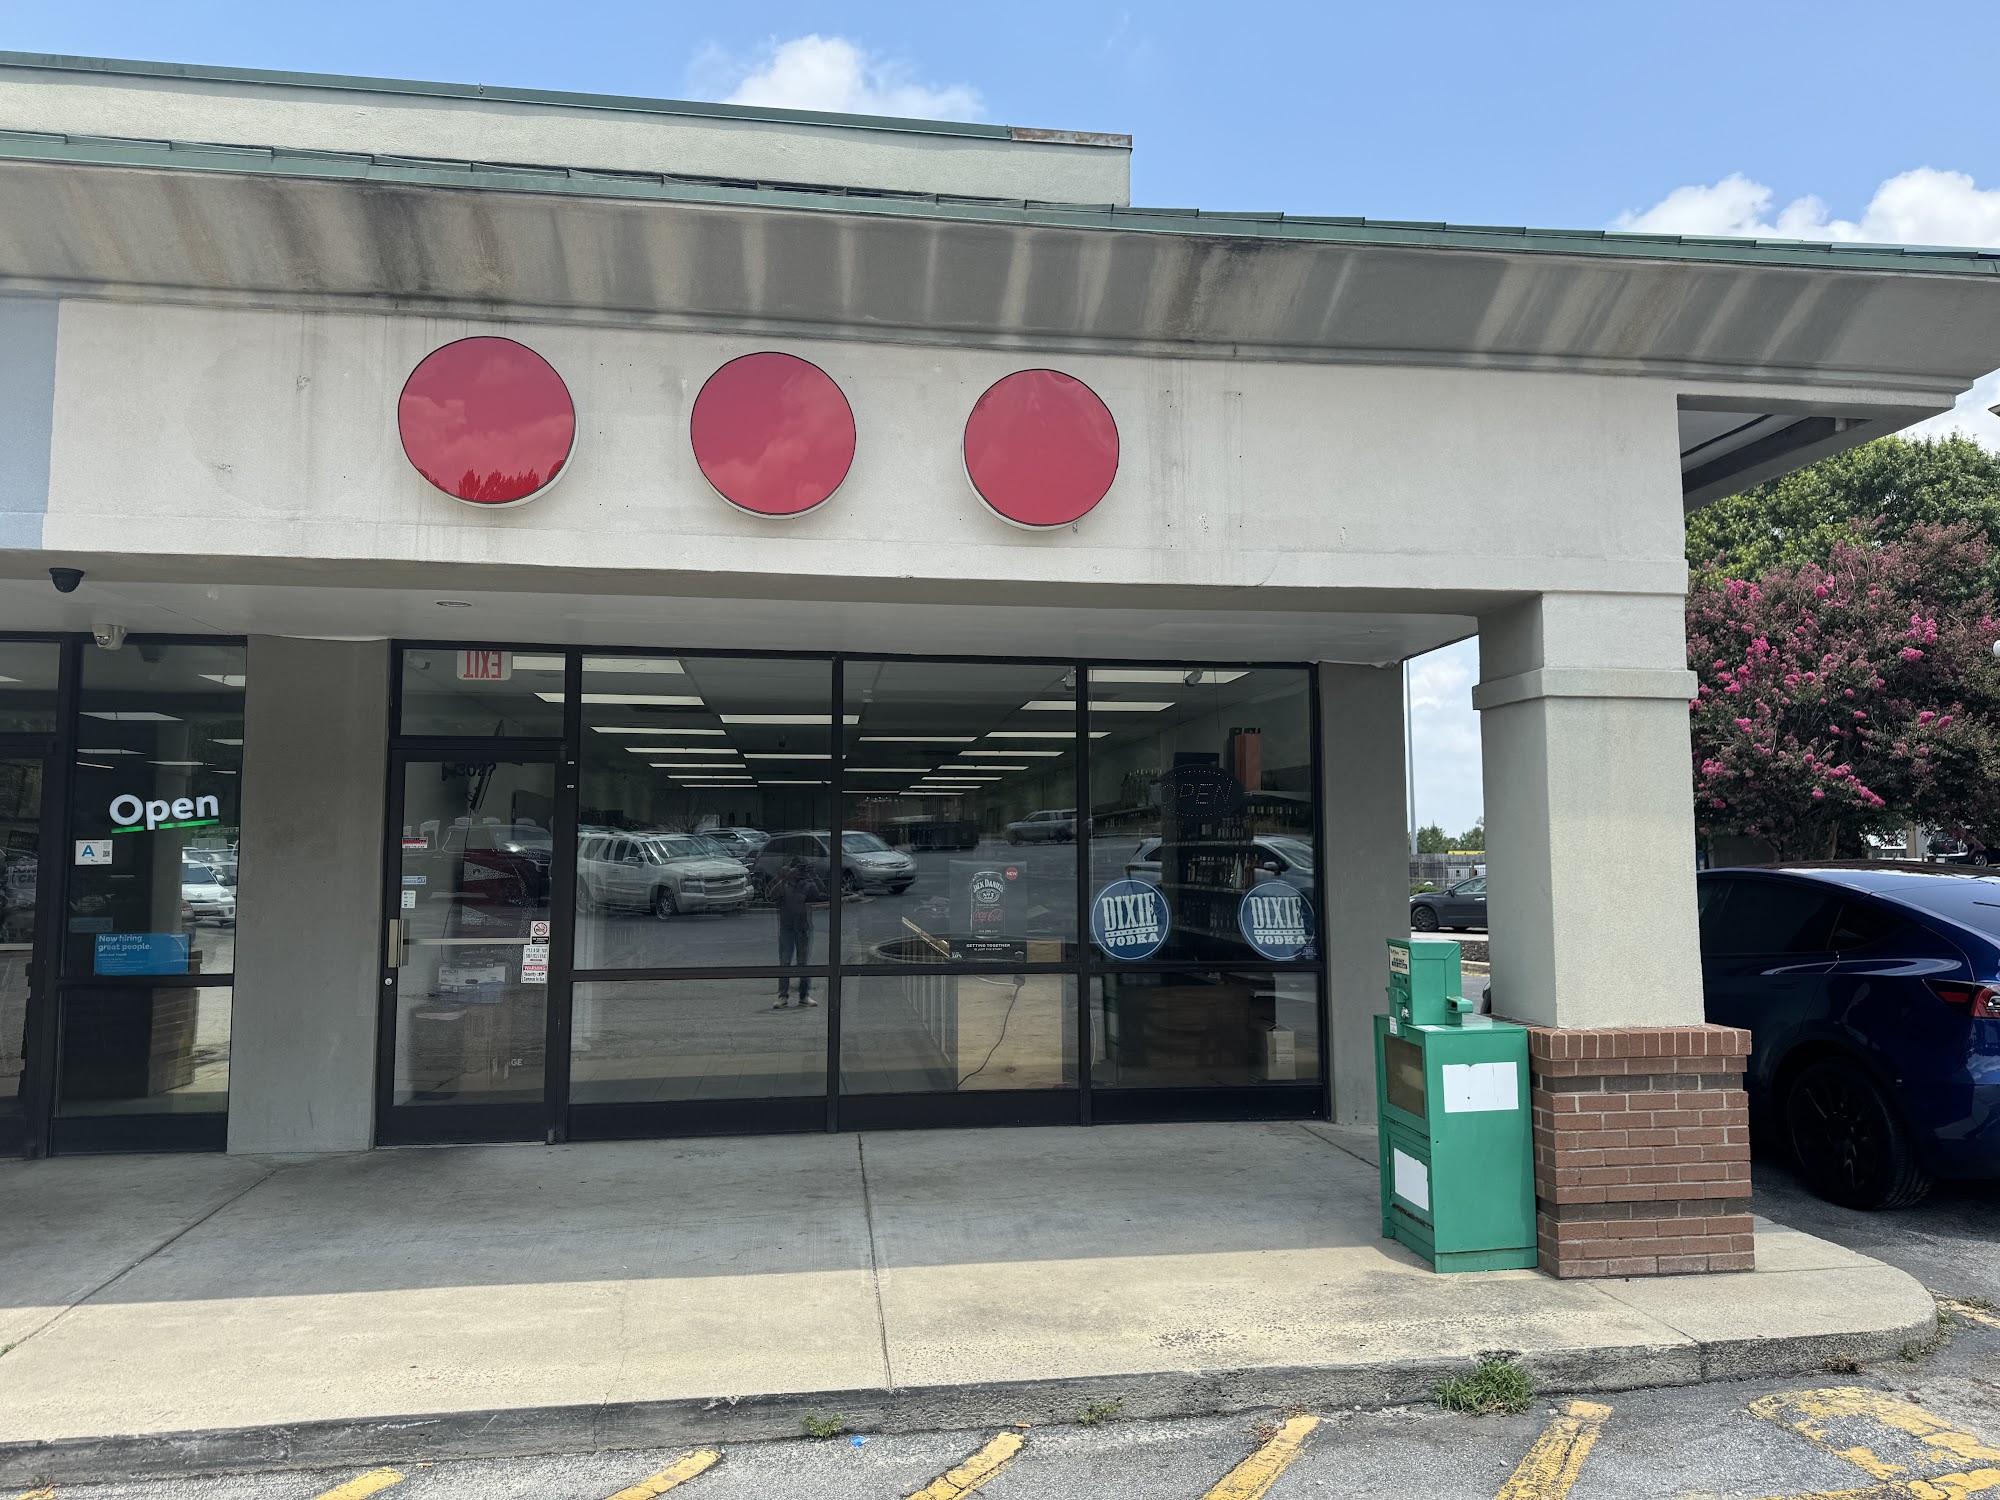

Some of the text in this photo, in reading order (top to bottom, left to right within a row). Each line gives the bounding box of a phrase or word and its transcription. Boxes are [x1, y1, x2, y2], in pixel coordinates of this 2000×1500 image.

[1160, 783, 1232, 804] OPEN
[109, 794, 219, 831] Open
[81, 845, 95, 857] A
[972, 881, 985, 893] JACK
[1102, 892, 1158, 931] DIXIE
[1249, 896, 1305, 929] DIXIE
[119, 934, 143, 943] hiring
[1105, 932, 1160, 948] VODKA
[1254, 935, 1307, 945] VODKA
[98, 943, 152, 952] great people.
